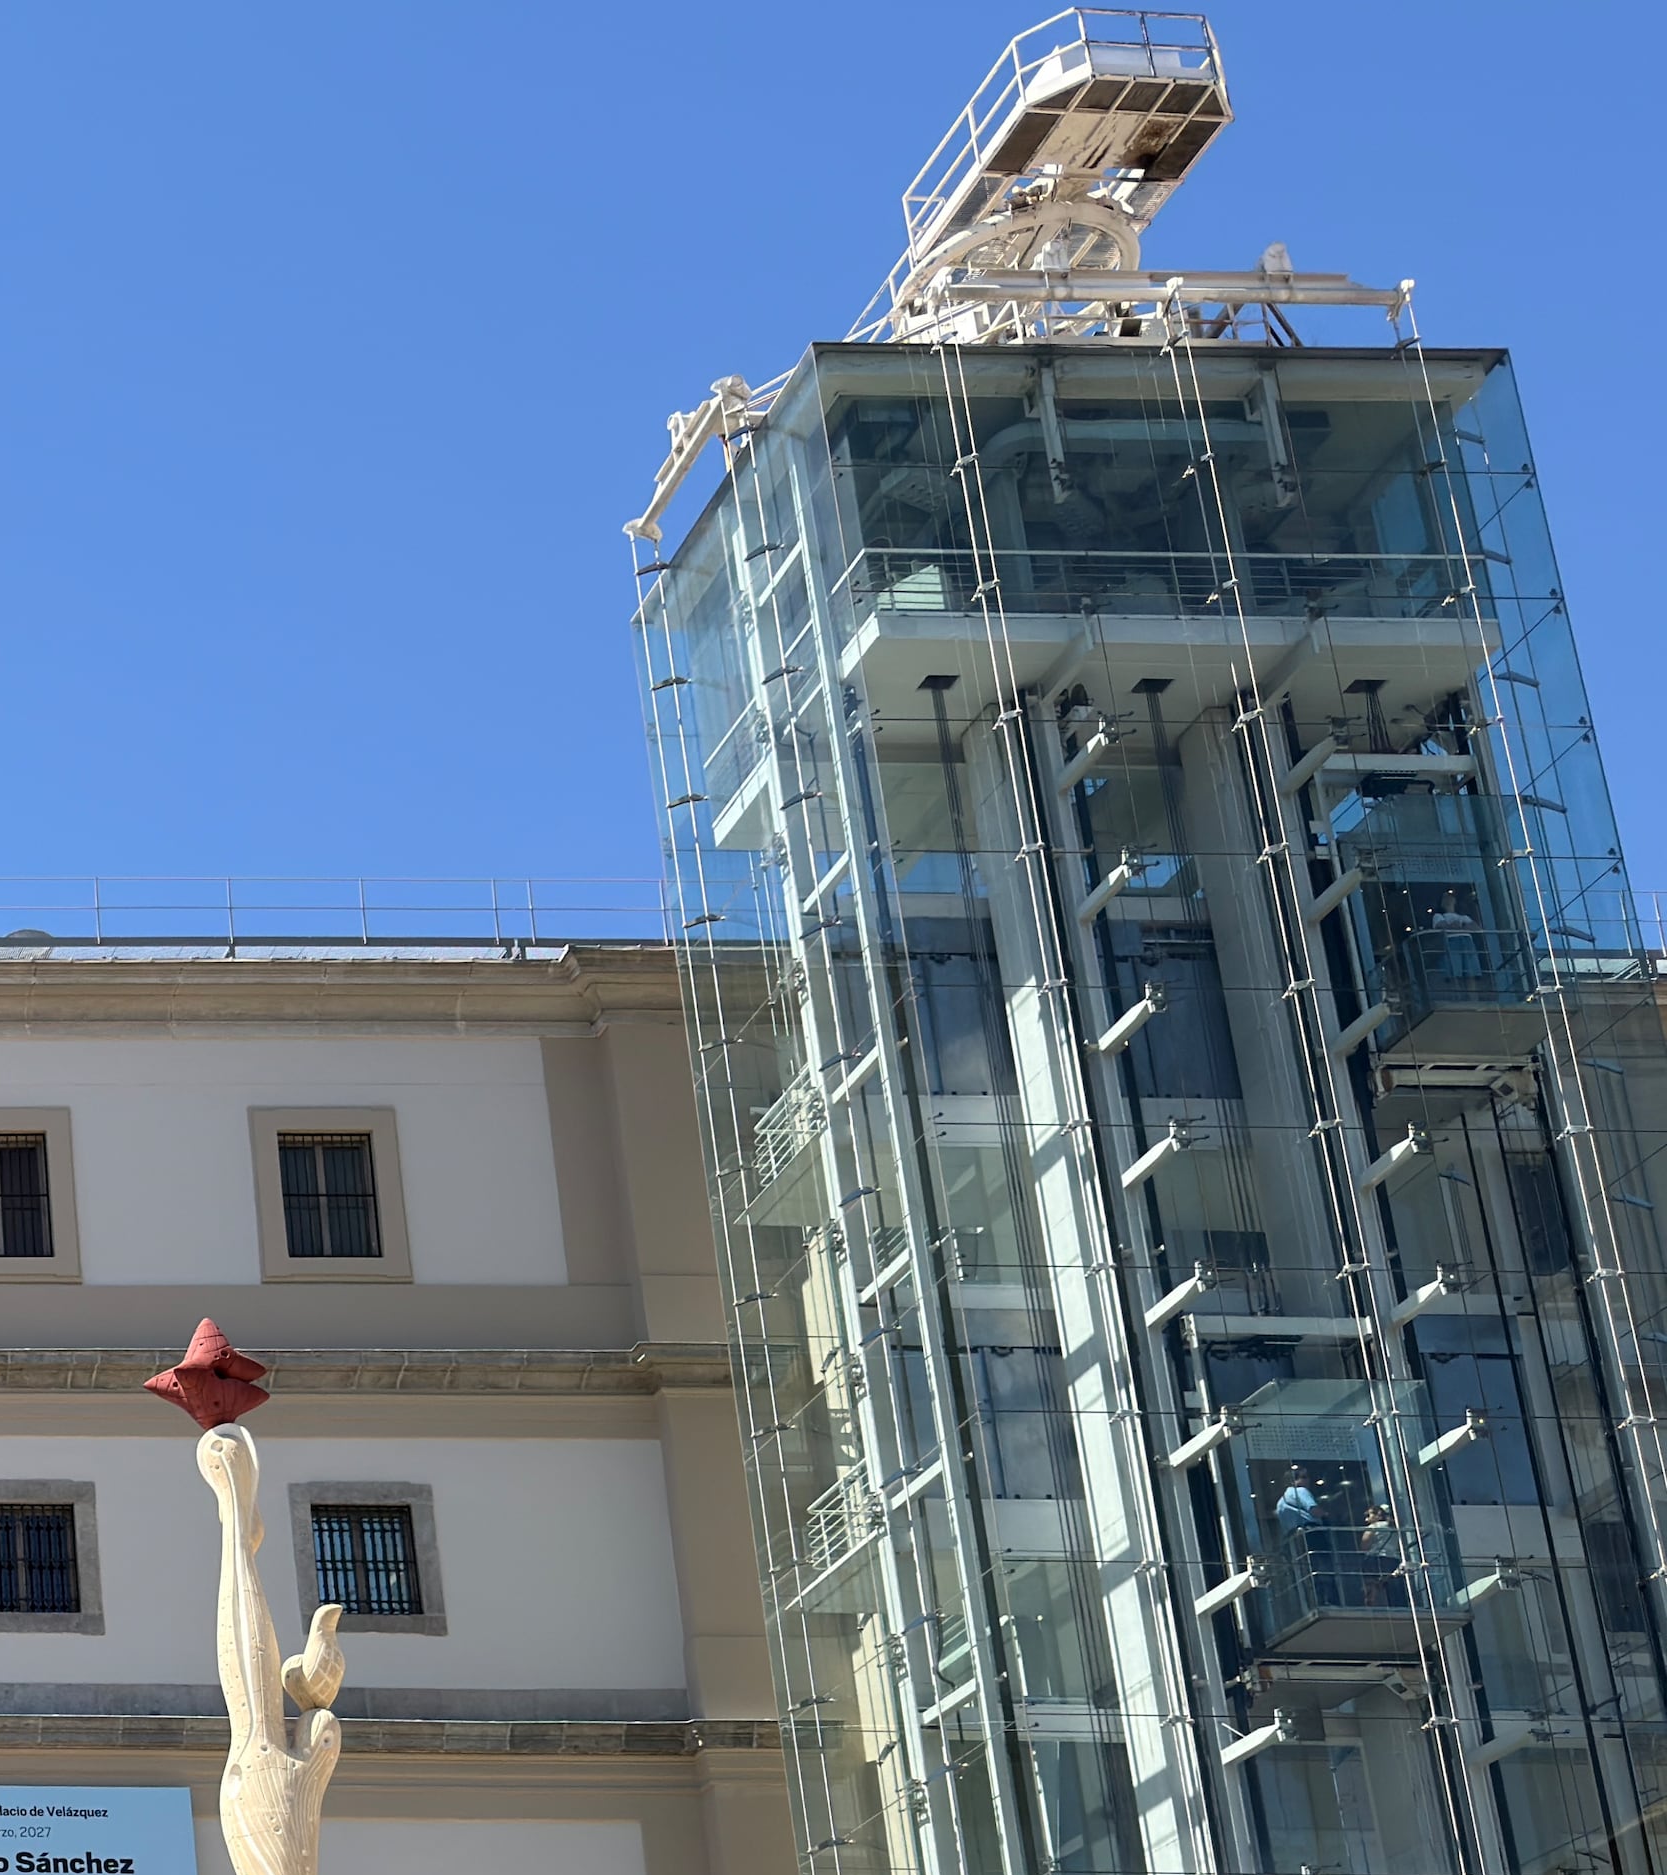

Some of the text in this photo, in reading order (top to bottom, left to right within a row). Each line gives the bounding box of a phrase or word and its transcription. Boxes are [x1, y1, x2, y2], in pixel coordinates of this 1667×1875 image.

[29, 1806, 44, 1817] de
[46, 1806, 108, 1820] Velázquez
[19, 1826, 51, 1838] 2027
[15, 1851, 135, 1874] Sánchez
